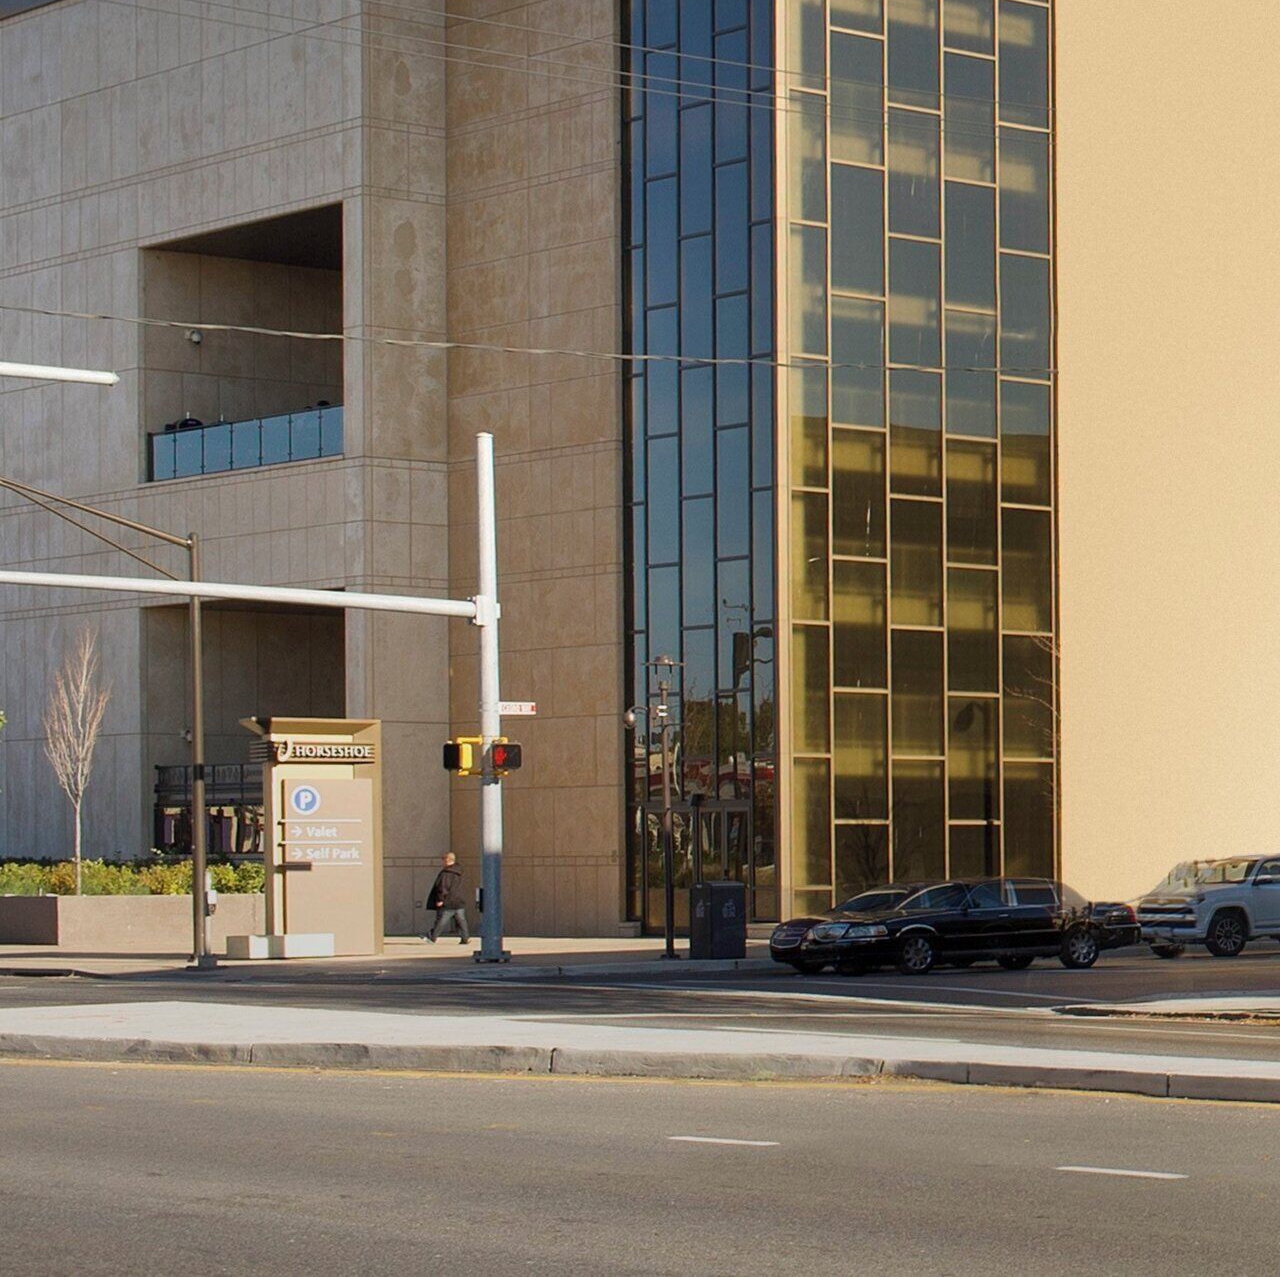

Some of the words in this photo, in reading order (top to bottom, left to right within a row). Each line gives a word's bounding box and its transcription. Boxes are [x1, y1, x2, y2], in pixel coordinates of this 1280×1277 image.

[296, 744, 371, 757] HORSESHOE
[306, 826, 338, 838] Valet
[306, 848, 329, 859] Self
[333, 848, 360, 859] Park
